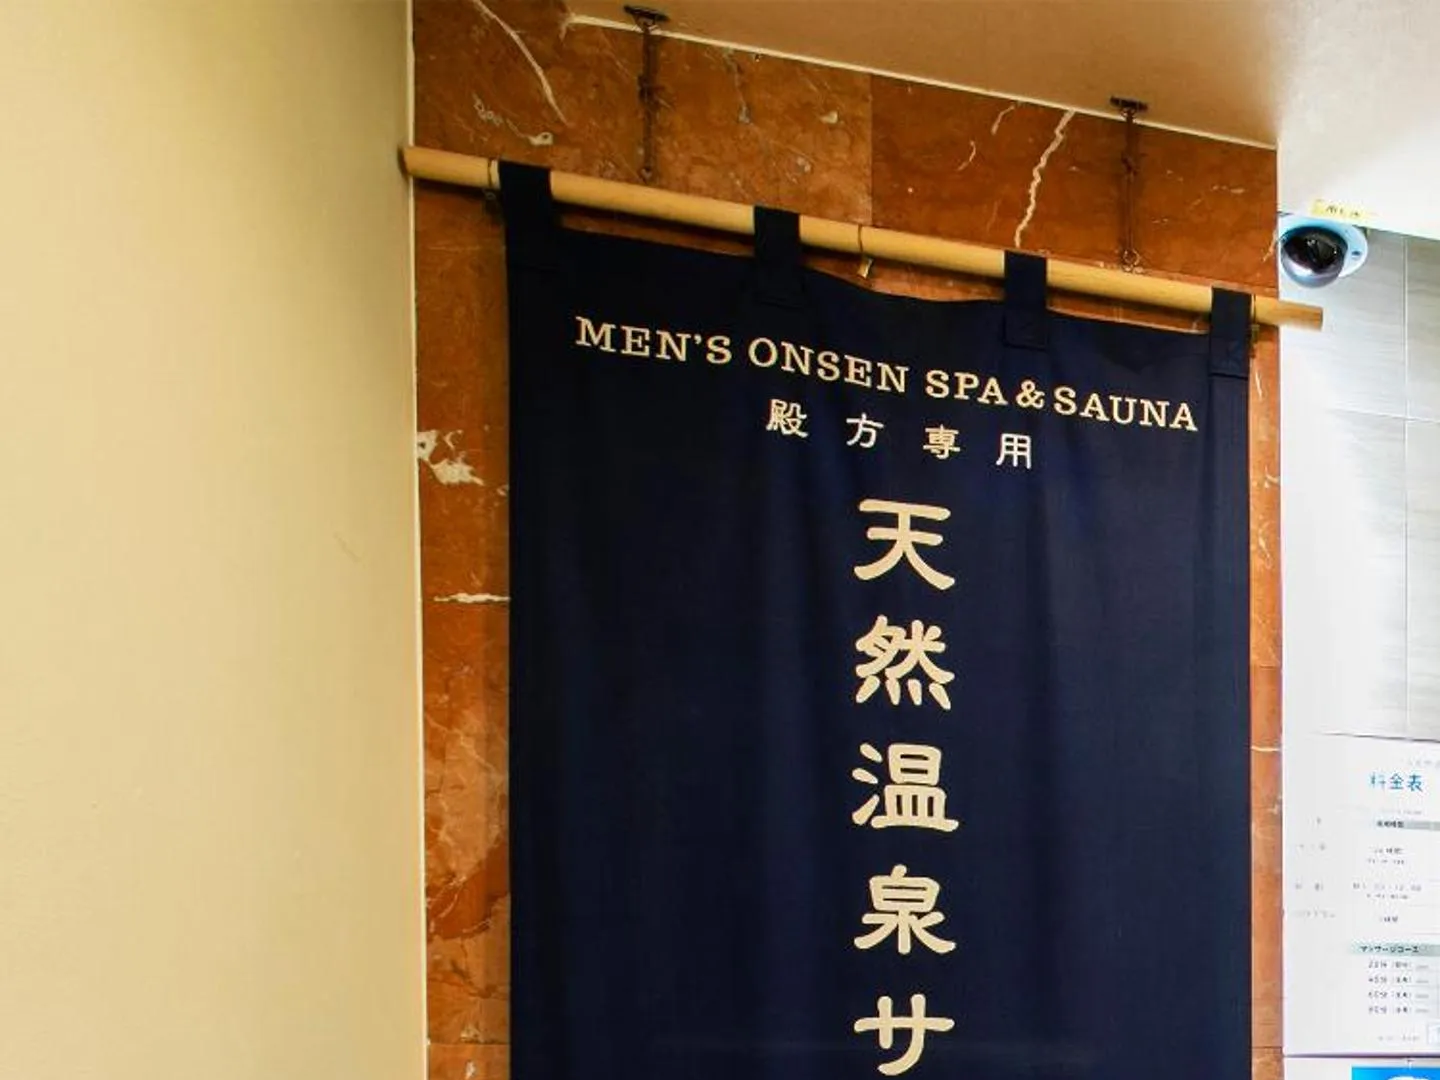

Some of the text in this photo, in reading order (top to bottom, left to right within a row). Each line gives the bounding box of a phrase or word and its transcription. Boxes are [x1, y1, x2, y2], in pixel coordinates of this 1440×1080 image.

[576, 316, 731, 363] MEN'S
[749, 338, 909, 393] ONSEN
[766, 398, 1032, 469] 殿方専用
[1370, 773, 1423, 792] 料金表
